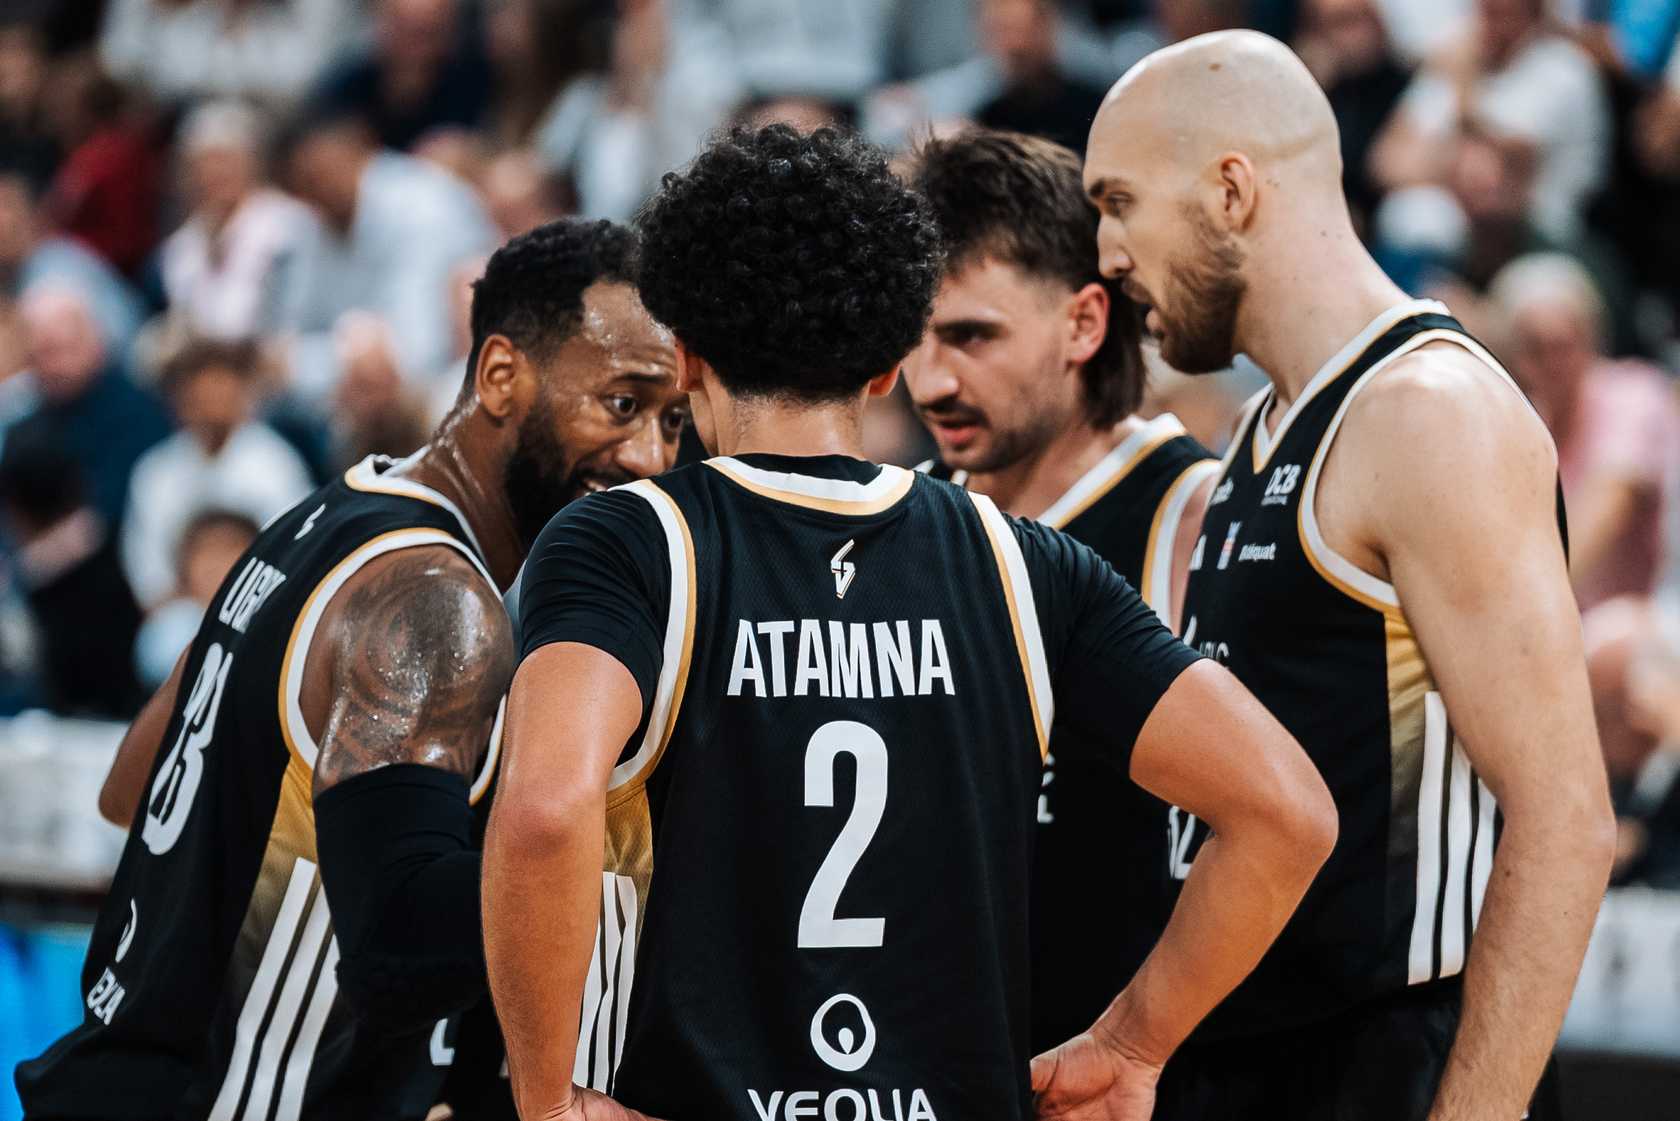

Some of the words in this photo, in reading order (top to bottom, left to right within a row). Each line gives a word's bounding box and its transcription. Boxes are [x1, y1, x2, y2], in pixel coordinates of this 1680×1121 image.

[727, 618, 955, 699] ATAMNA
[797, 720, 888, 948] 2
[747, 1088, 938, 1121] VEOLIA
